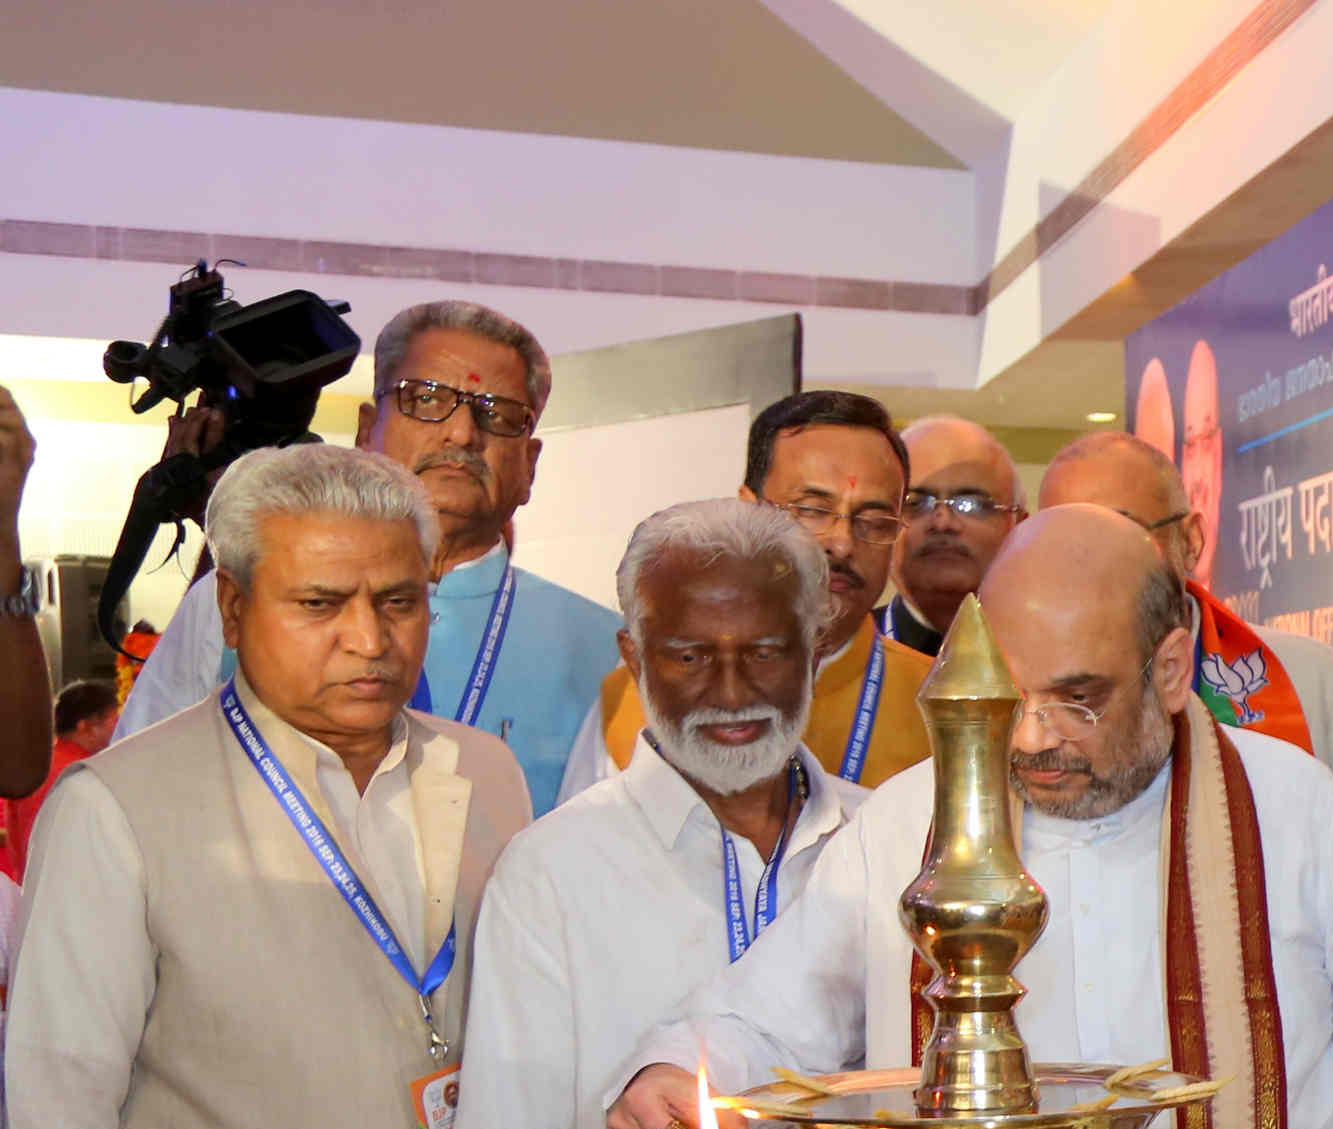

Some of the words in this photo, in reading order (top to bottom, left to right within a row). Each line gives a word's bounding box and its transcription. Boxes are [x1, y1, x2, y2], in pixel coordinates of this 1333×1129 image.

[1237, 465, 1294, 589] राष्ट्रीय
[238, 720, 265, 760] NATIONAL
[260, 757, 288, 793] COUNCIL
[282, 790, 312, 828] MEETING
